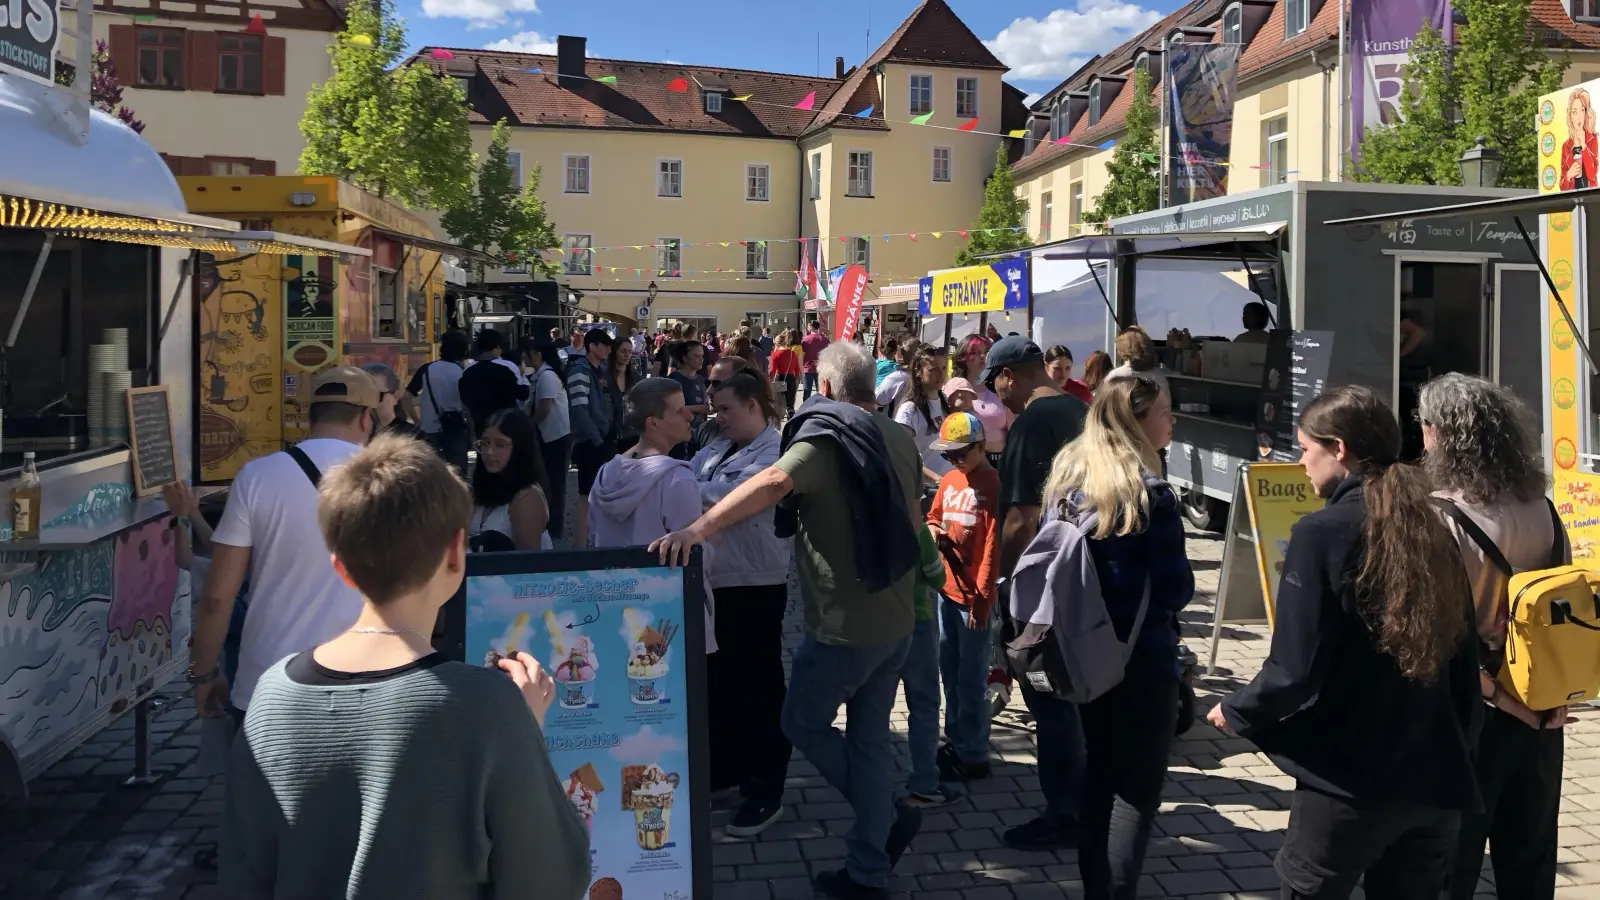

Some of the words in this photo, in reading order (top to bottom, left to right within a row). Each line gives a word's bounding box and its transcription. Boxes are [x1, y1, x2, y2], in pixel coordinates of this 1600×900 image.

[0, 0, 54, 43] IS
[1177, 167, 1206, 176] HIER
[1427, 225, 1452, 236] Taste
[1455, 227, 1465, 236] of
[1477, 222, 1539, 244] Tempua
[943, 275, 989, 308] GETRÄNKE
